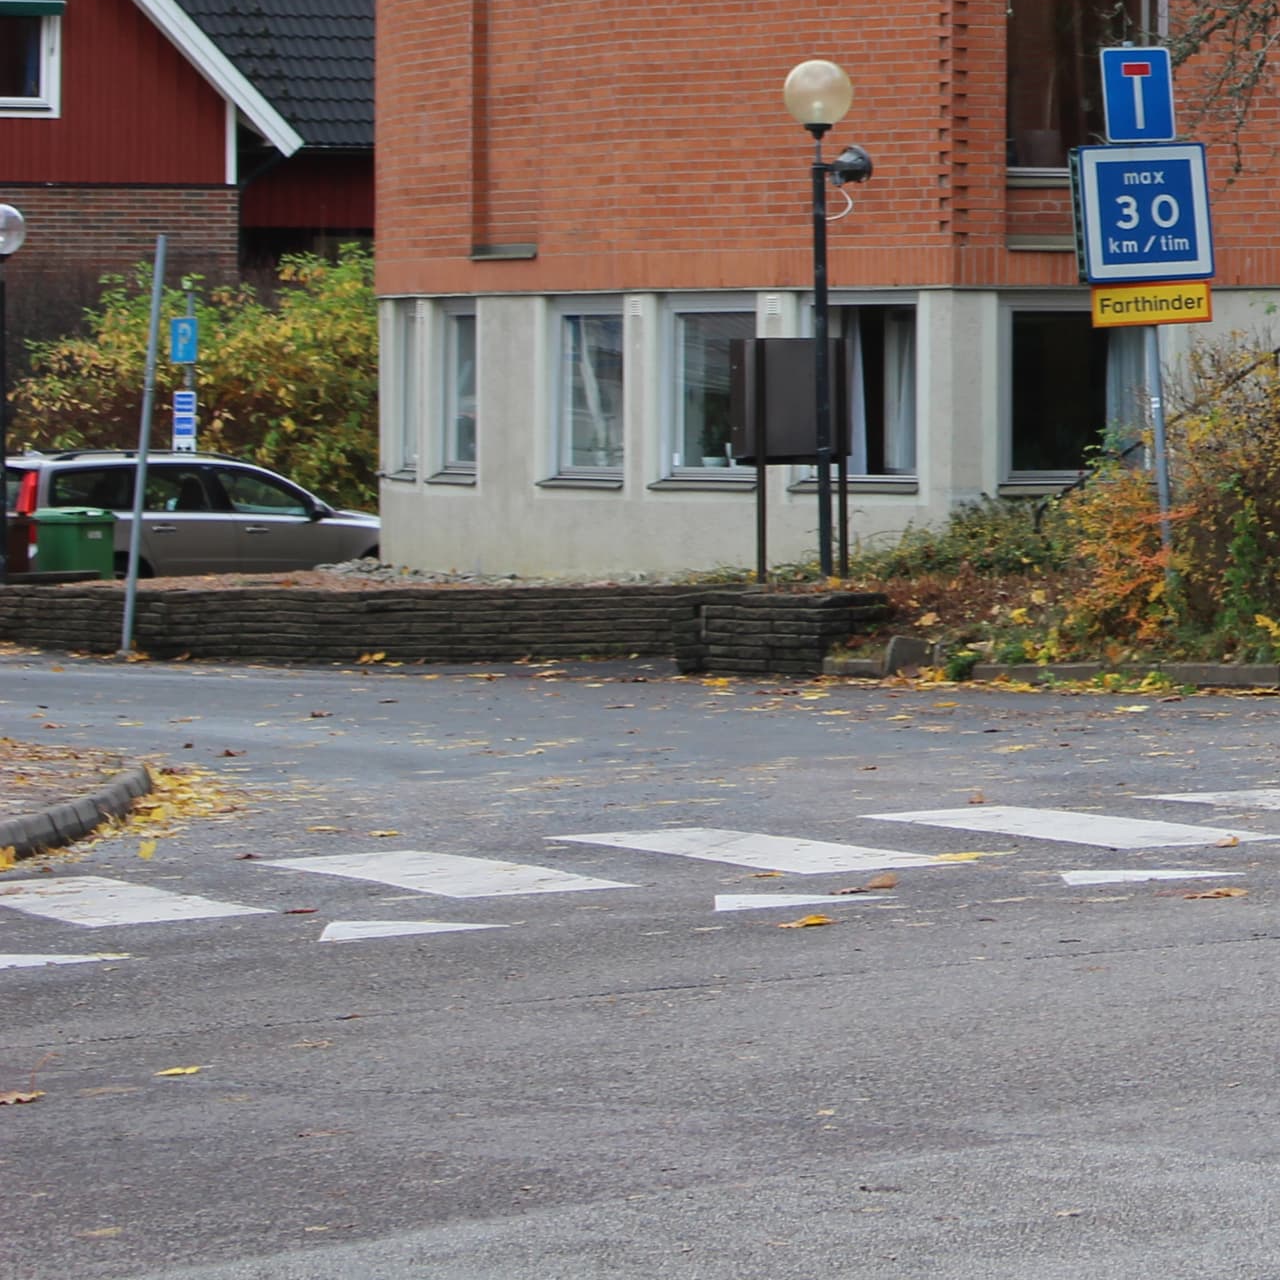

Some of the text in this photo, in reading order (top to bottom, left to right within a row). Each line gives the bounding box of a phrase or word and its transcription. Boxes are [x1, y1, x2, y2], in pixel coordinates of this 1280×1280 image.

[1123, 171, 1164, 185] max
[1115, 194, 1179, 230] 30
[1100, 296, 1204, 314] Farthinder
[177, 322, 192, 358] P
